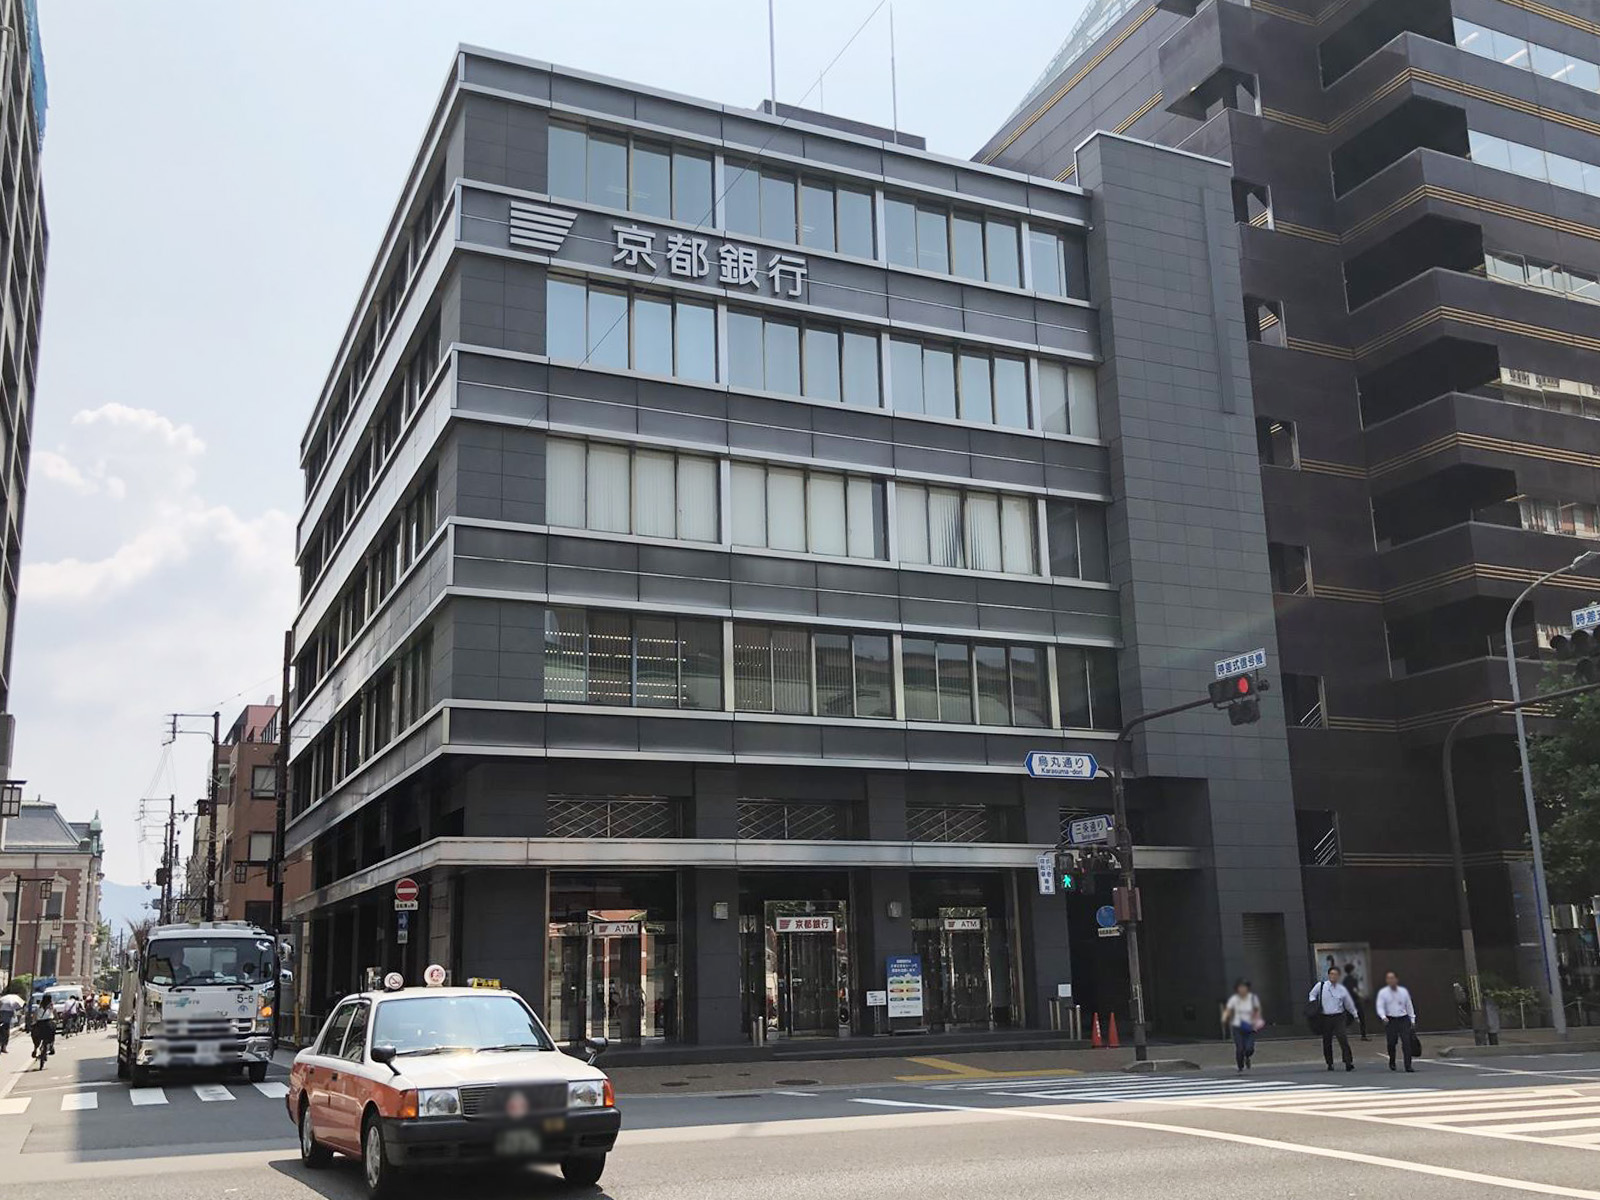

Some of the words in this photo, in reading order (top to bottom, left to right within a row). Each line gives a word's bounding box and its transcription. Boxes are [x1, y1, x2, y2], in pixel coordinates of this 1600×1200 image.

[613, 225, 808, 297] 京都銀行
[1217, 652, 1263, 675] 時差式信号機
[1038, 755, 1084, 769] 烏丸通り
[614, 924, 635, 933] ATM
[795, 917, 830, 930] 京都銀行
[960, 920, 977, 928] ATM
[236, 993, 254, 1004] 5-5
